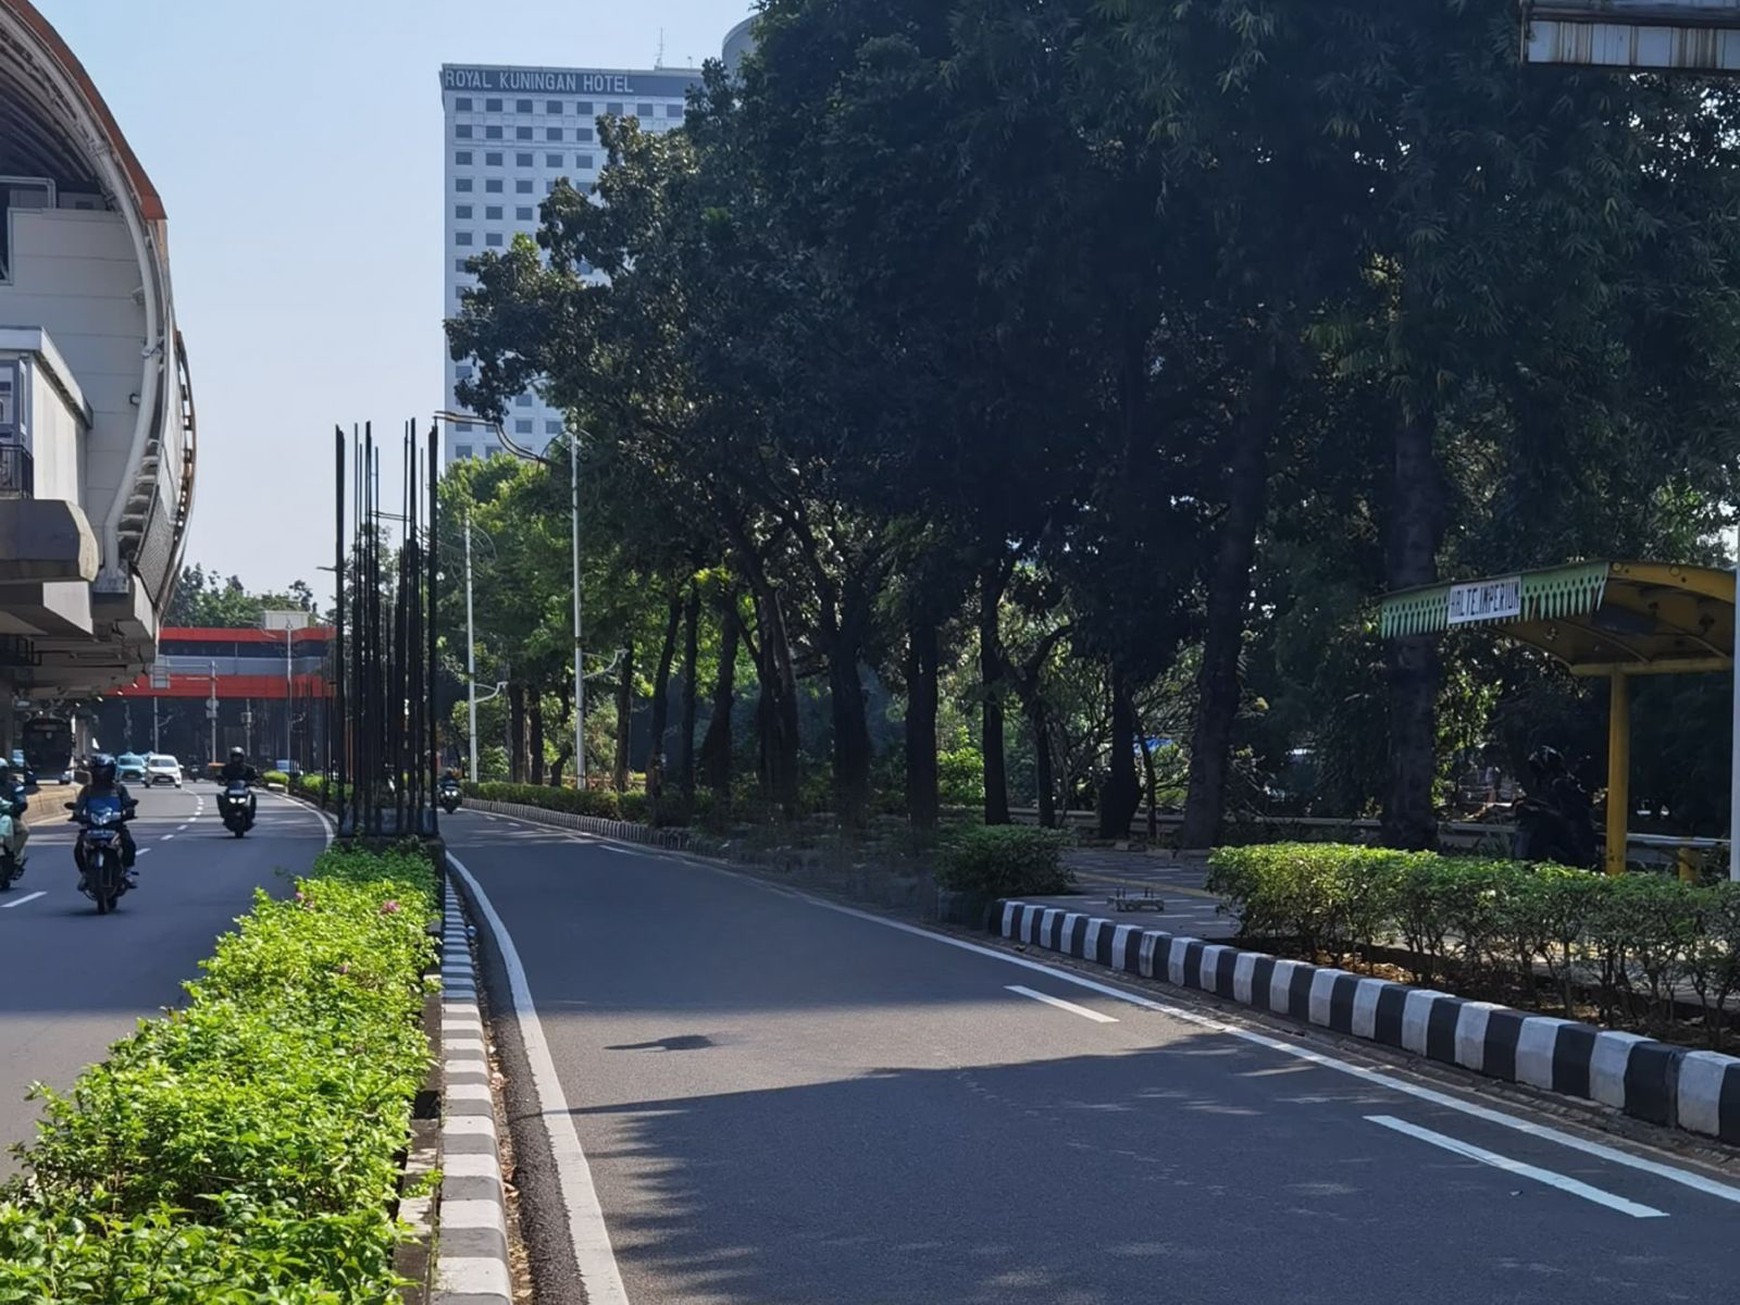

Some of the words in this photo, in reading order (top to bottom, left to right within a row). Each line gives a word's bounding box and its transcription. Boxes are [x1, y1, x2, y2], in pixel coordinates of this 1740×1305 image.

[445, 70, 492, 88] ROYAL
[500, 72, 576, 91] KUNINGAN
[583, 75, 634, 92] HOTEL
